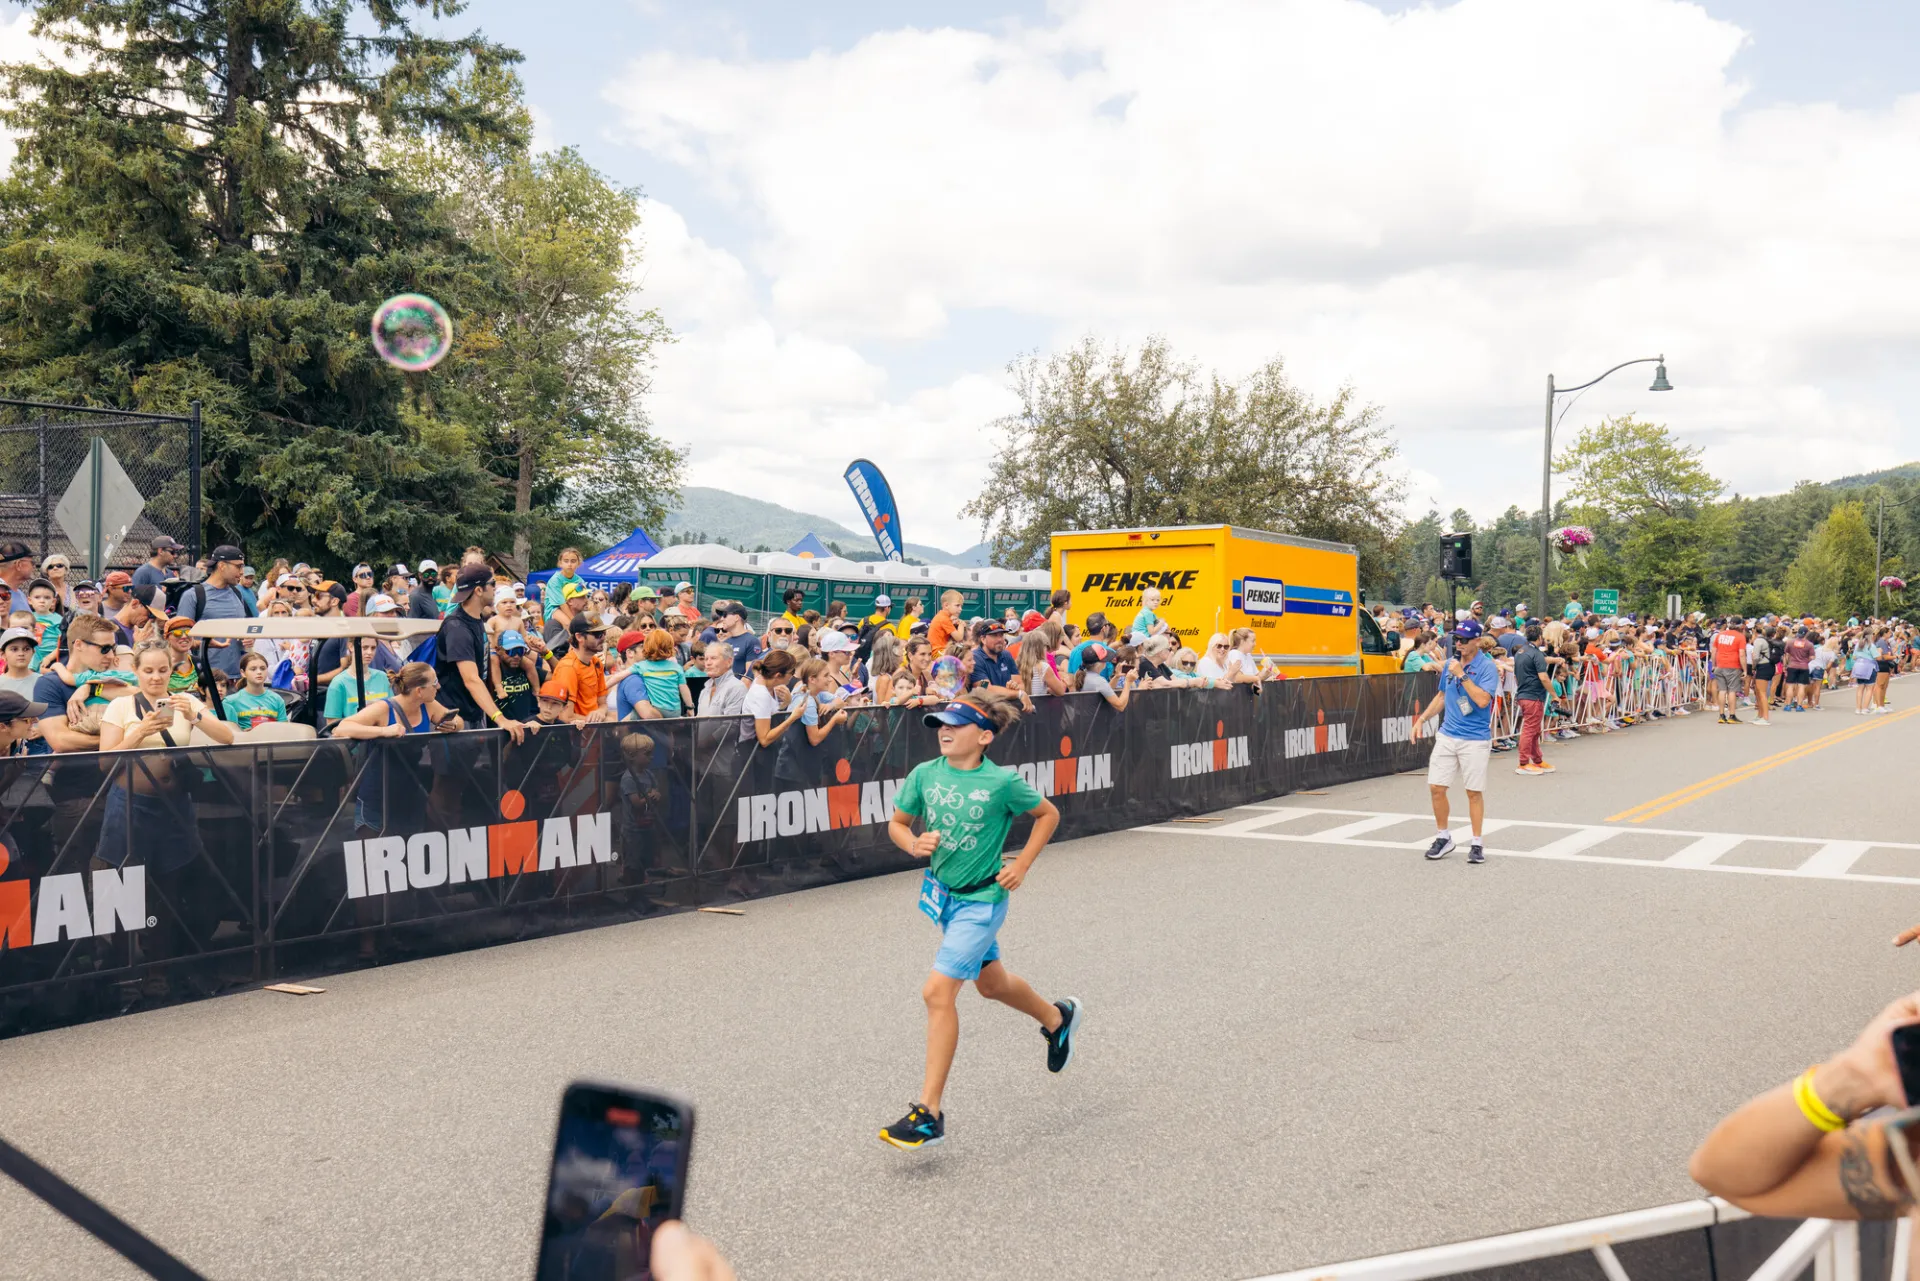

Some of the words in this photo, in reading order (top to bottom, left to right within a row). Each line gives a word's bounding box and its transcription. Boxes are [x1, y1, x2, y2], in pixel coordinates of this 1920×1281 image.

[1081, 570, 1199, 593] PENSKE
[1105, 596, 1134, 607] Truck
[1246, 589, 1280, 604] PENSKE
[1250, 618, 1262, 627] Truck
[1262, 619, 1277, 628] Rental
